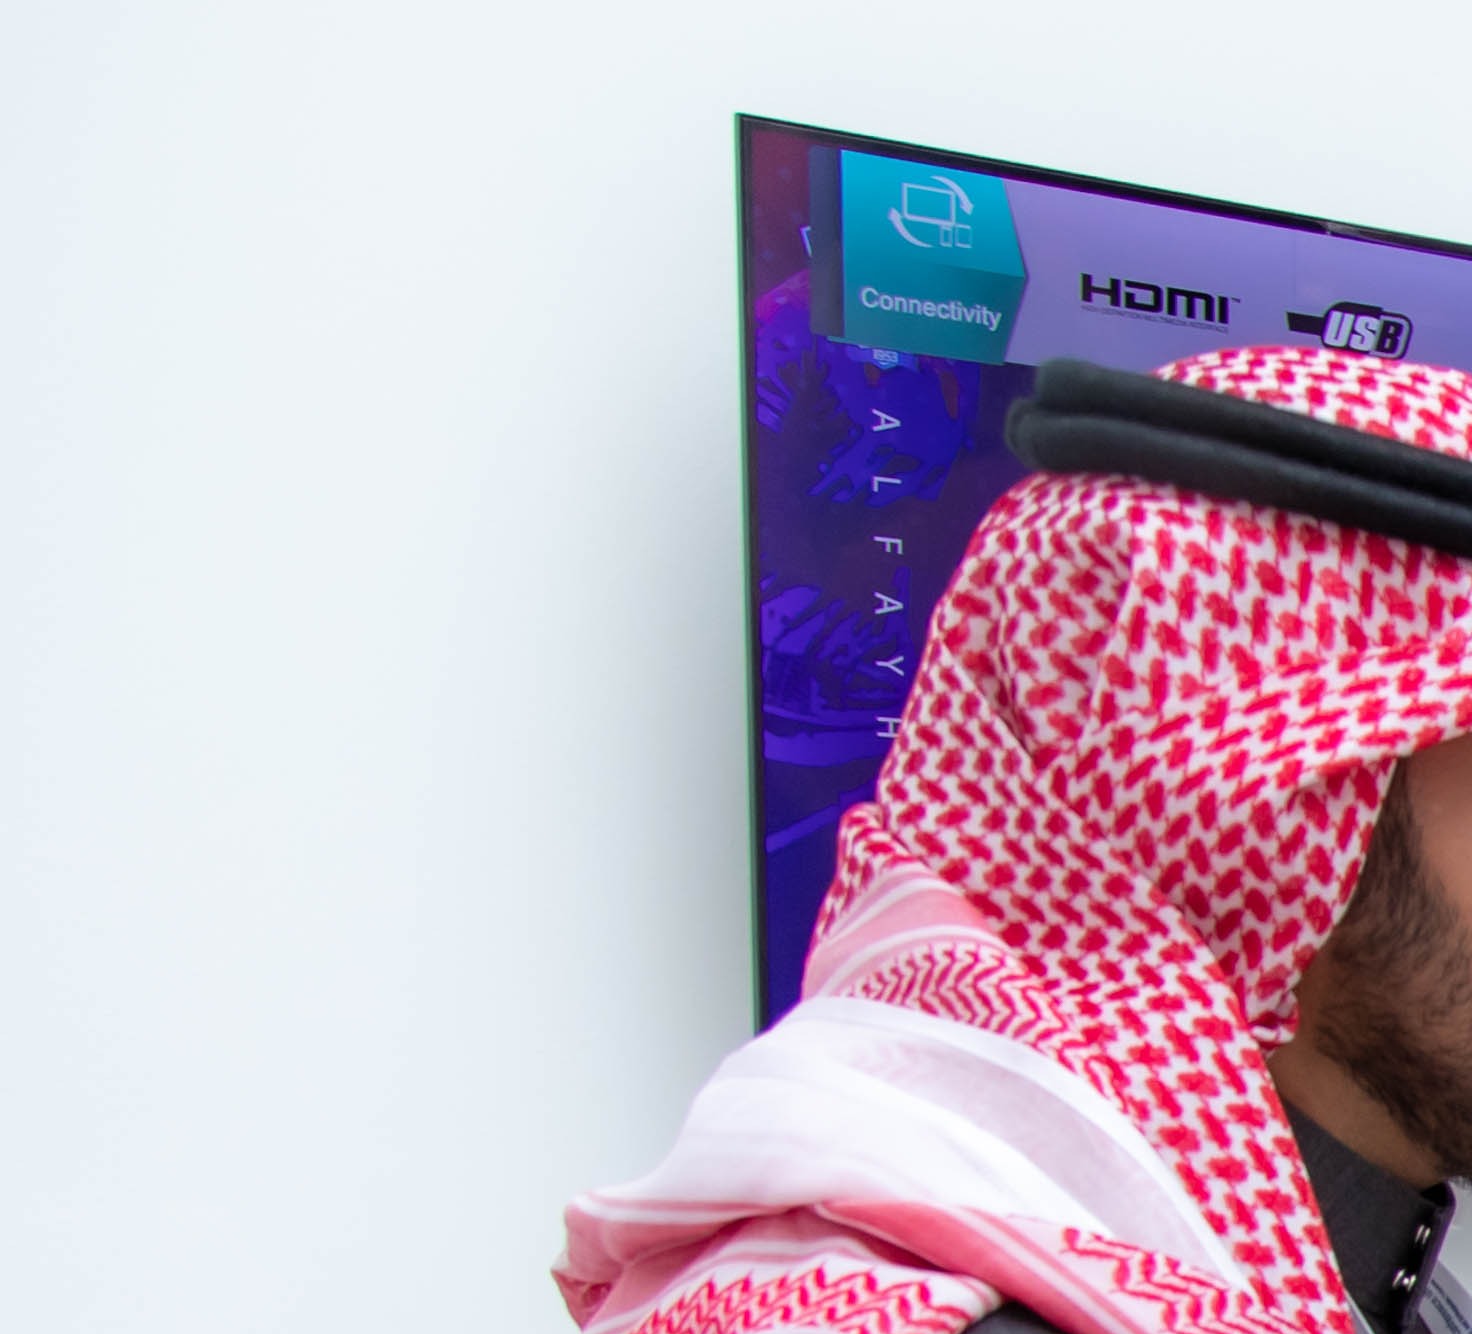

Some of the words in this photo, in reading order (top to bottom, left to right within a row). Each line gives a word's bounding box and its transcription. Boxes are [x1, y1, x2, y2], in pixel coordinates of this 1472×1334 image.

[860, 286, 1002, 332] Connectivity
[1080, 272, 1230, 325] HDMI
[1324, 308, 1403, 357] USB
[871, 407, 905, 739] ALFAYH
